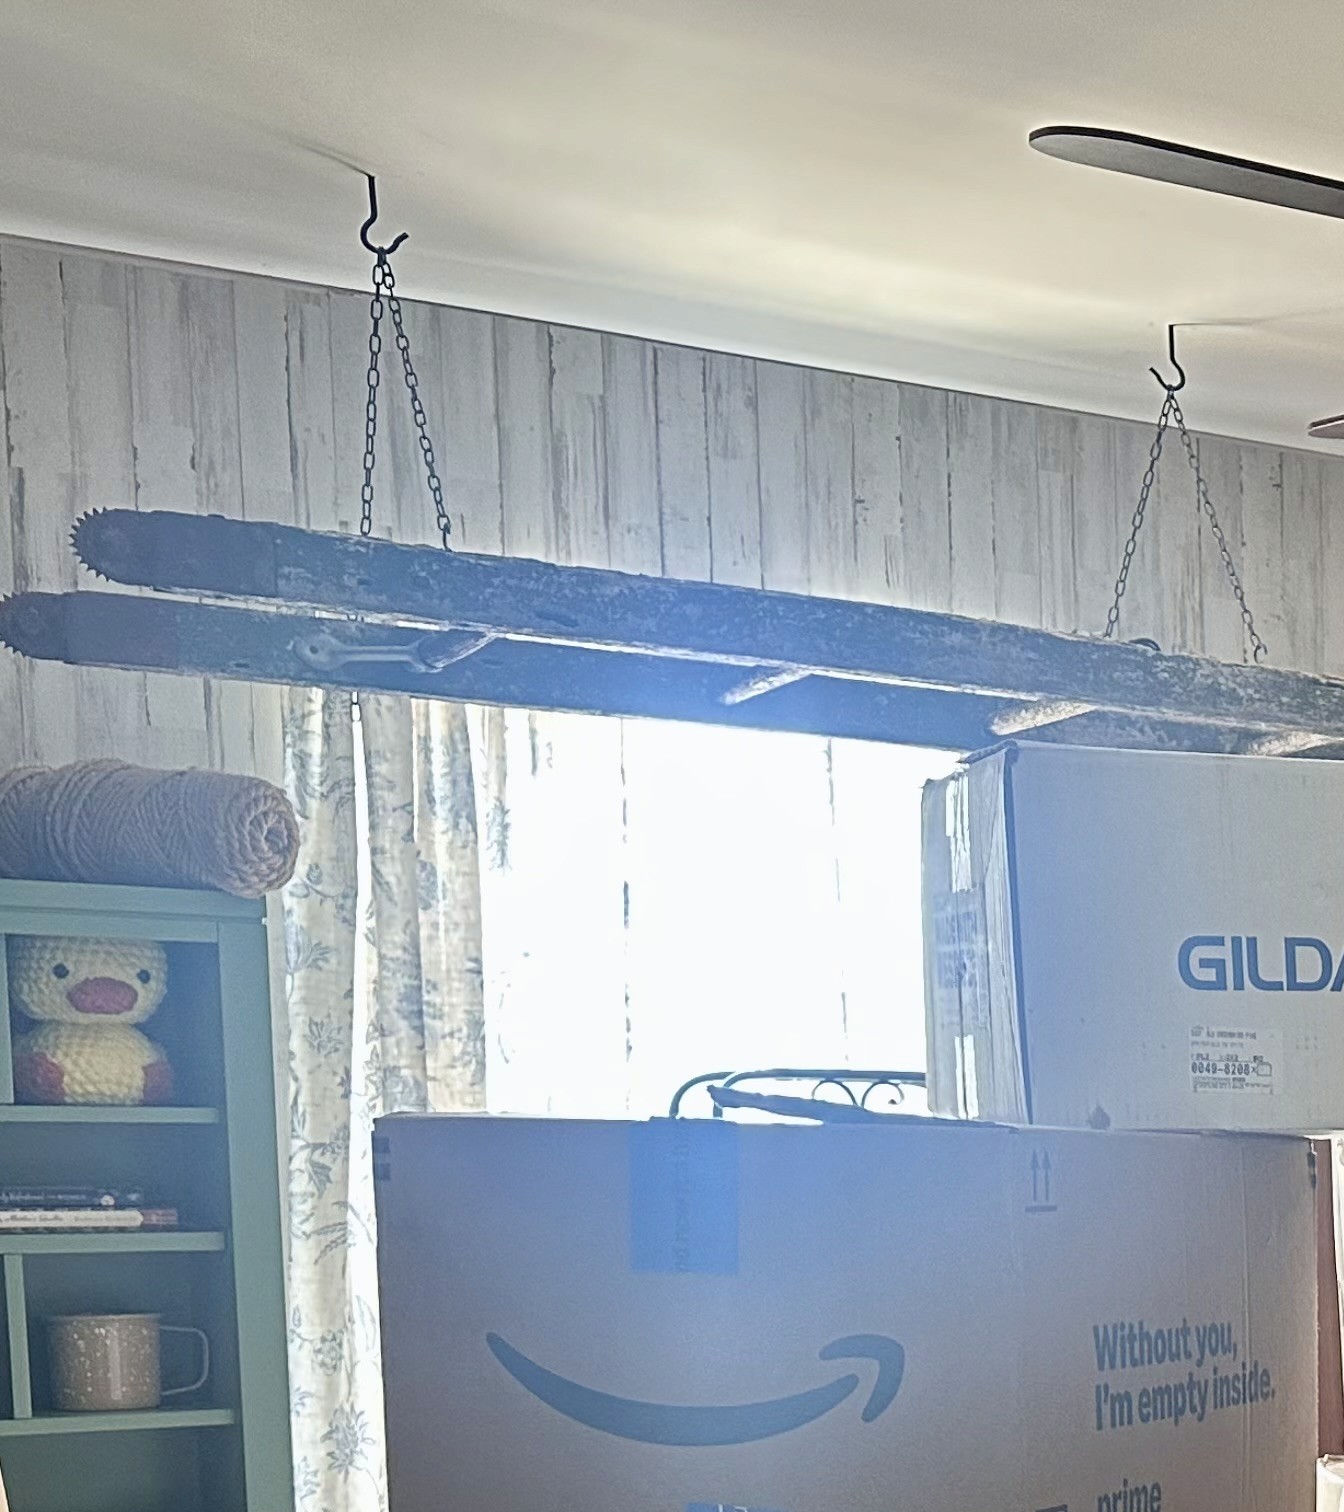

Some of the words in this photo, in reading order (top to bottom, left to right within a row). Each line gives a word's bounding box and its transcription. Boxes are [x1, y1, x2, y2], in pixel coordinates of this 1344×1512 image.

[1093, 1317, 1192, 1371] Without
[1196, 1320, 1239, 1368] you,
[1095, 1382, 1134, 1431] I'm
[1137, 1371, 1209, 1427] empty
[1213, 1360, 1276, 1409] inside.
